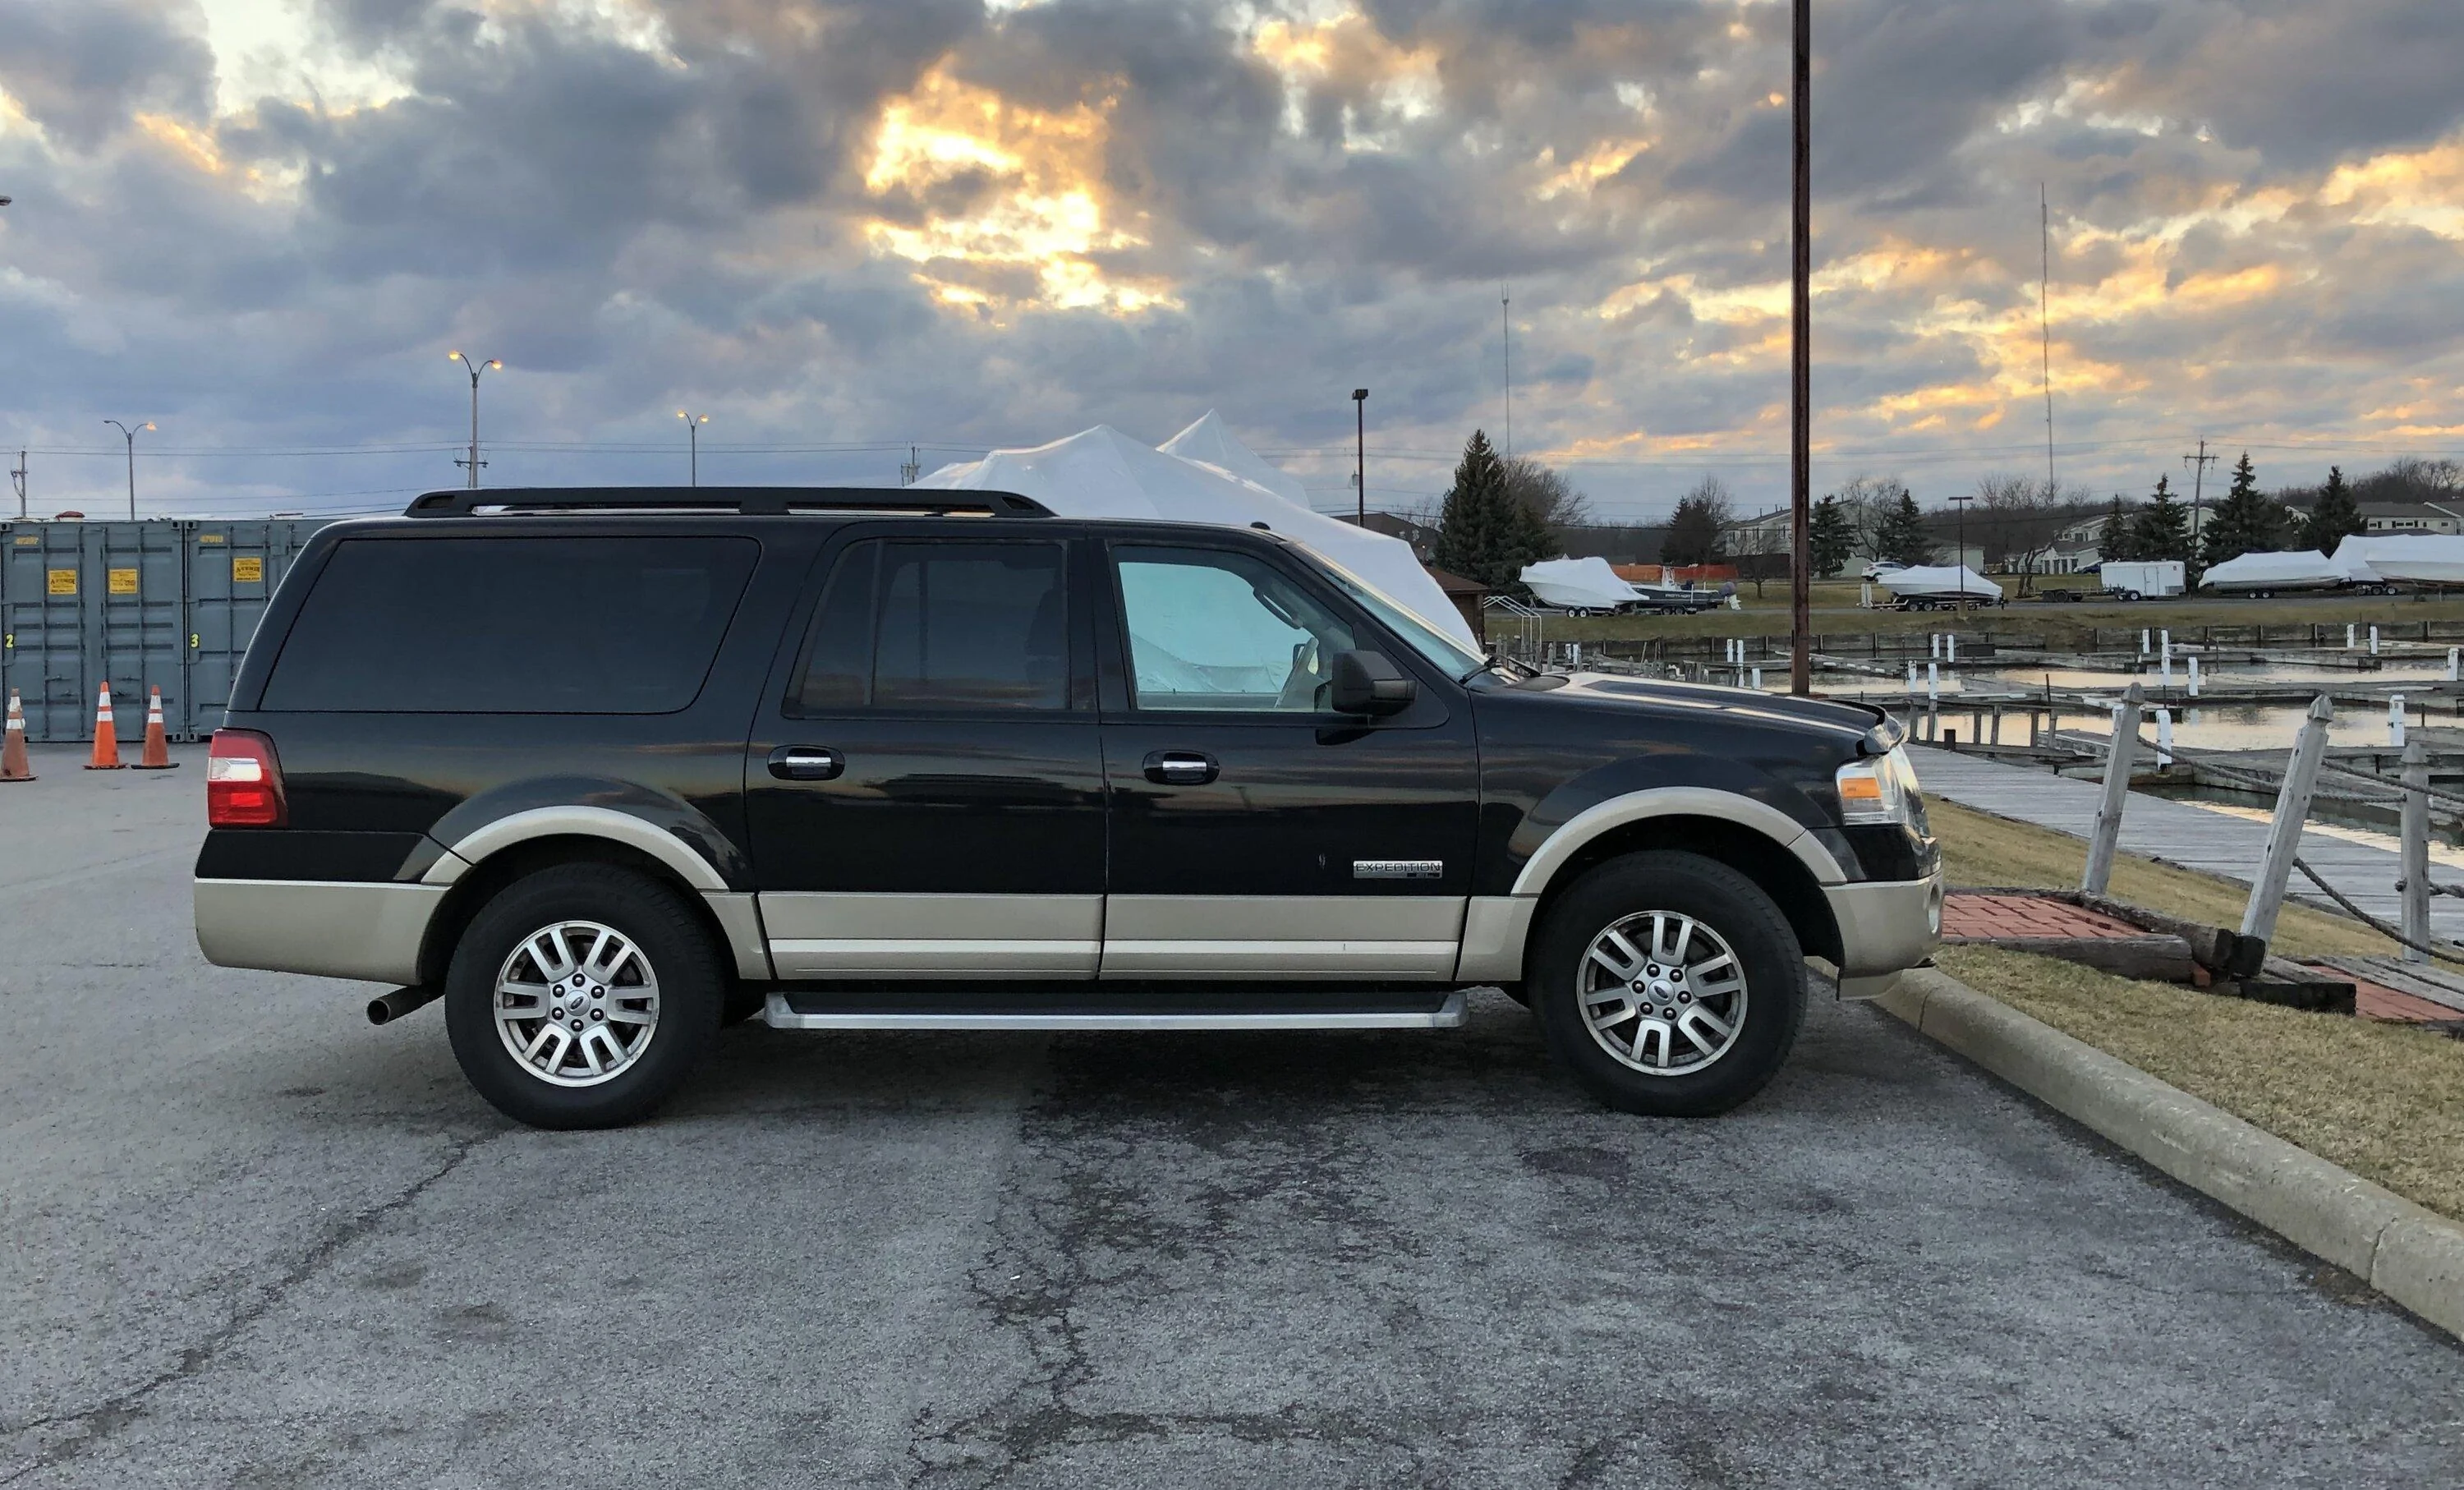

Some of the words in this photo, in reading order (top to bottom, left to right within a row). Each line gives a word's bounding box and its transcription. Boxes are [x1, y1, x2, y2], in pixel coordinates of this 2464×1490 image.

[6, 634, 14, 648] 2
[191, 634, 199, 648] 3
[1356, 863, 1441, 871] EXPEDITION
